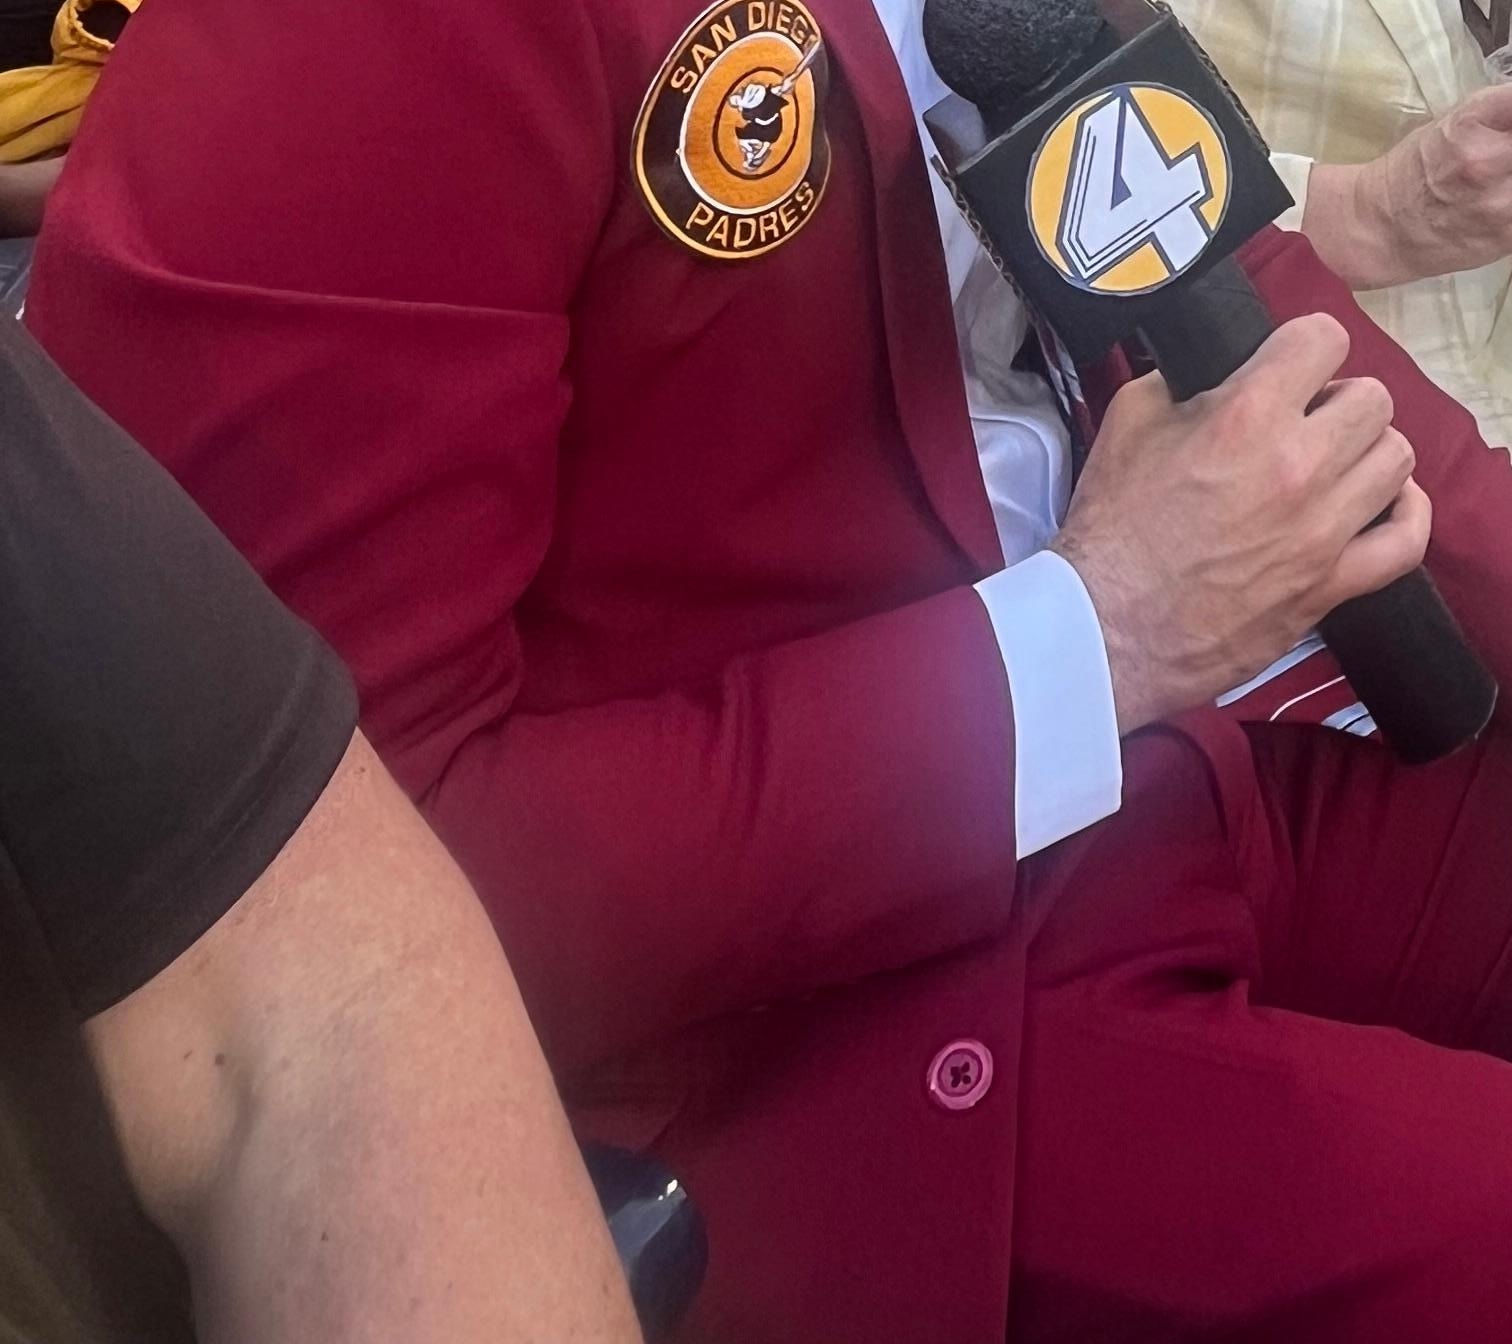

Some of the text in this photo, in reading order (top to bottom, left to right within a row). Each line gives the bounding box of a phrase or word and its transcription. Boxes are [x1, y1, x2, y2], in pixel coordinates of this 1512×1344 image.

[670, 0, 820, 94] SAN DIEG
[685, 180, 815, 249] PADRES
[1057, 90, 1210, 282] 4
